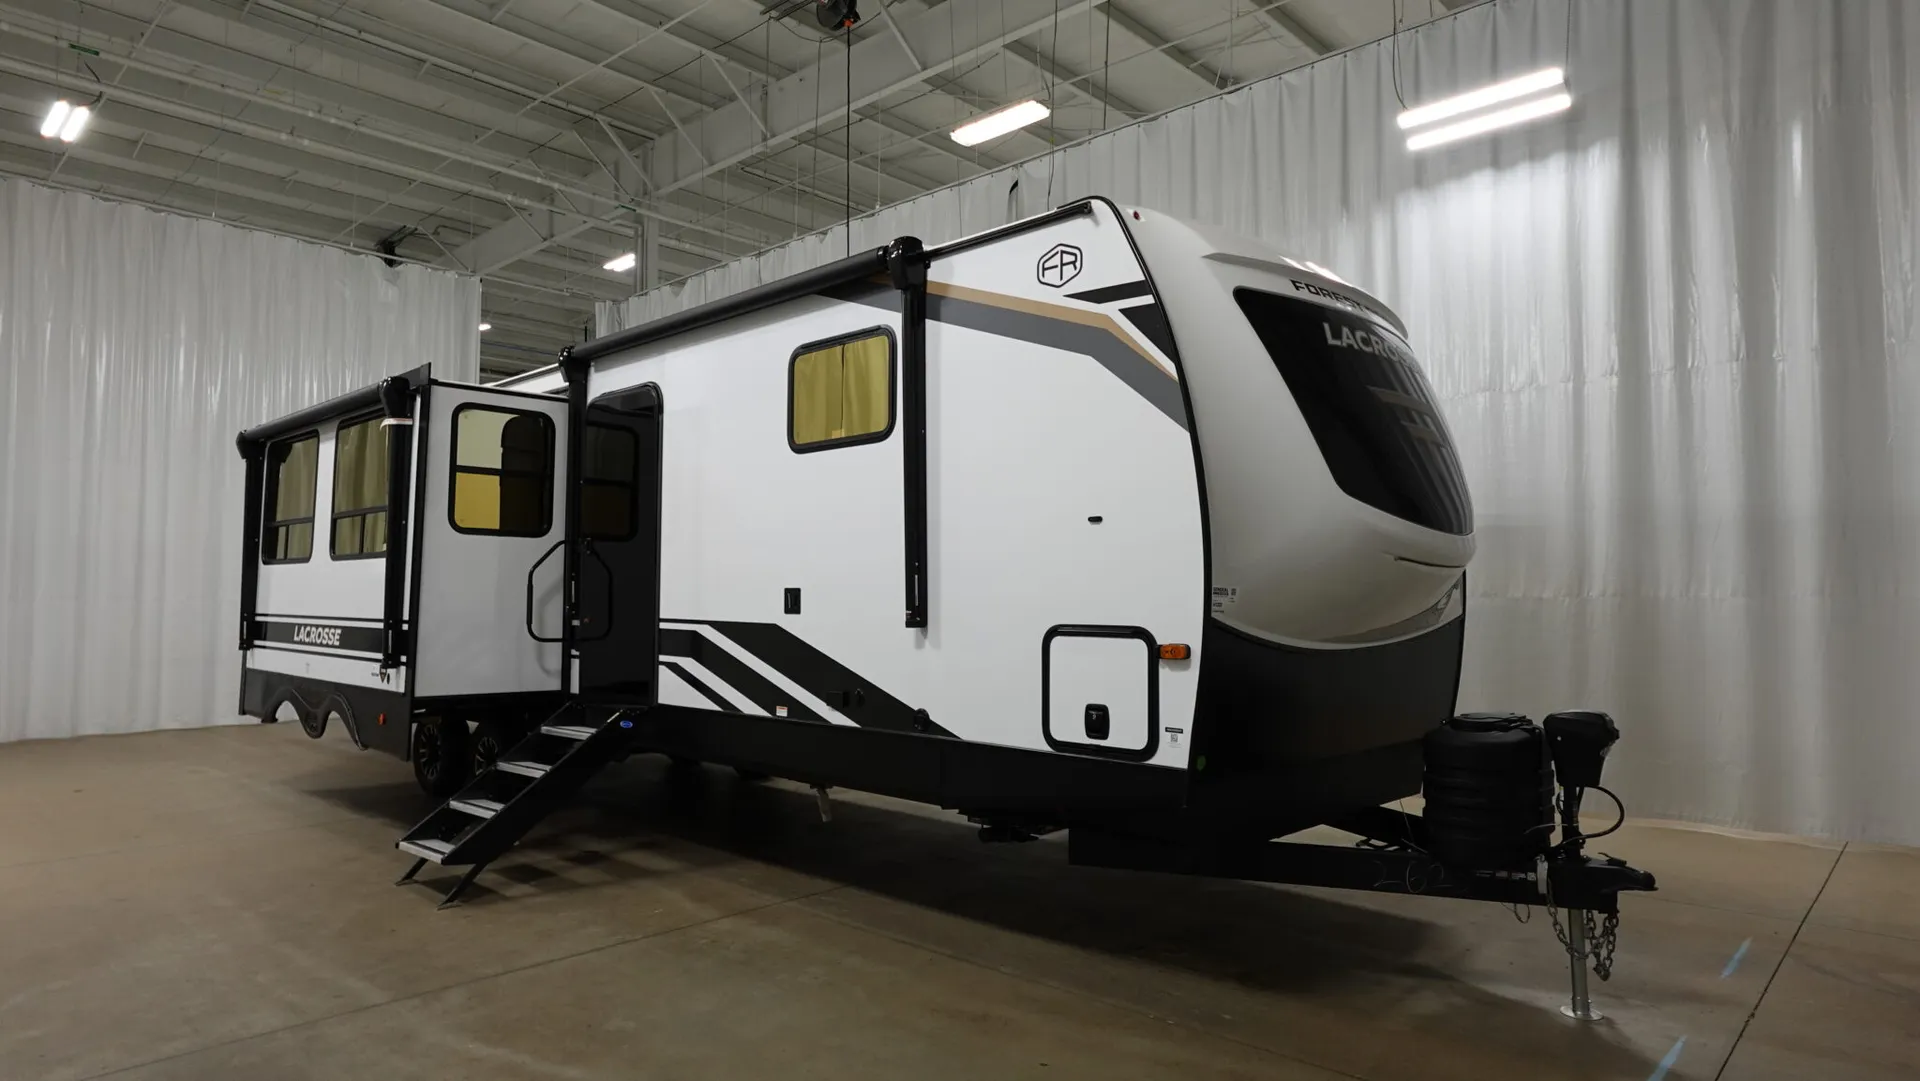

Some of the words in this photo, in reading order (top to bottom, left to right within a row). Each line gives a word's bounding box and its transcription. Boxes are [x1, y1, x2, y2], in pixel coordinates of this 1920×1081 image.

[1041, 248, 1079, 282] FR
[1290, 279, 1365, 312] FOREST
[1322, 321, 1408, 364] LACRO
[293, 624, 342, 646] LACROSSE
